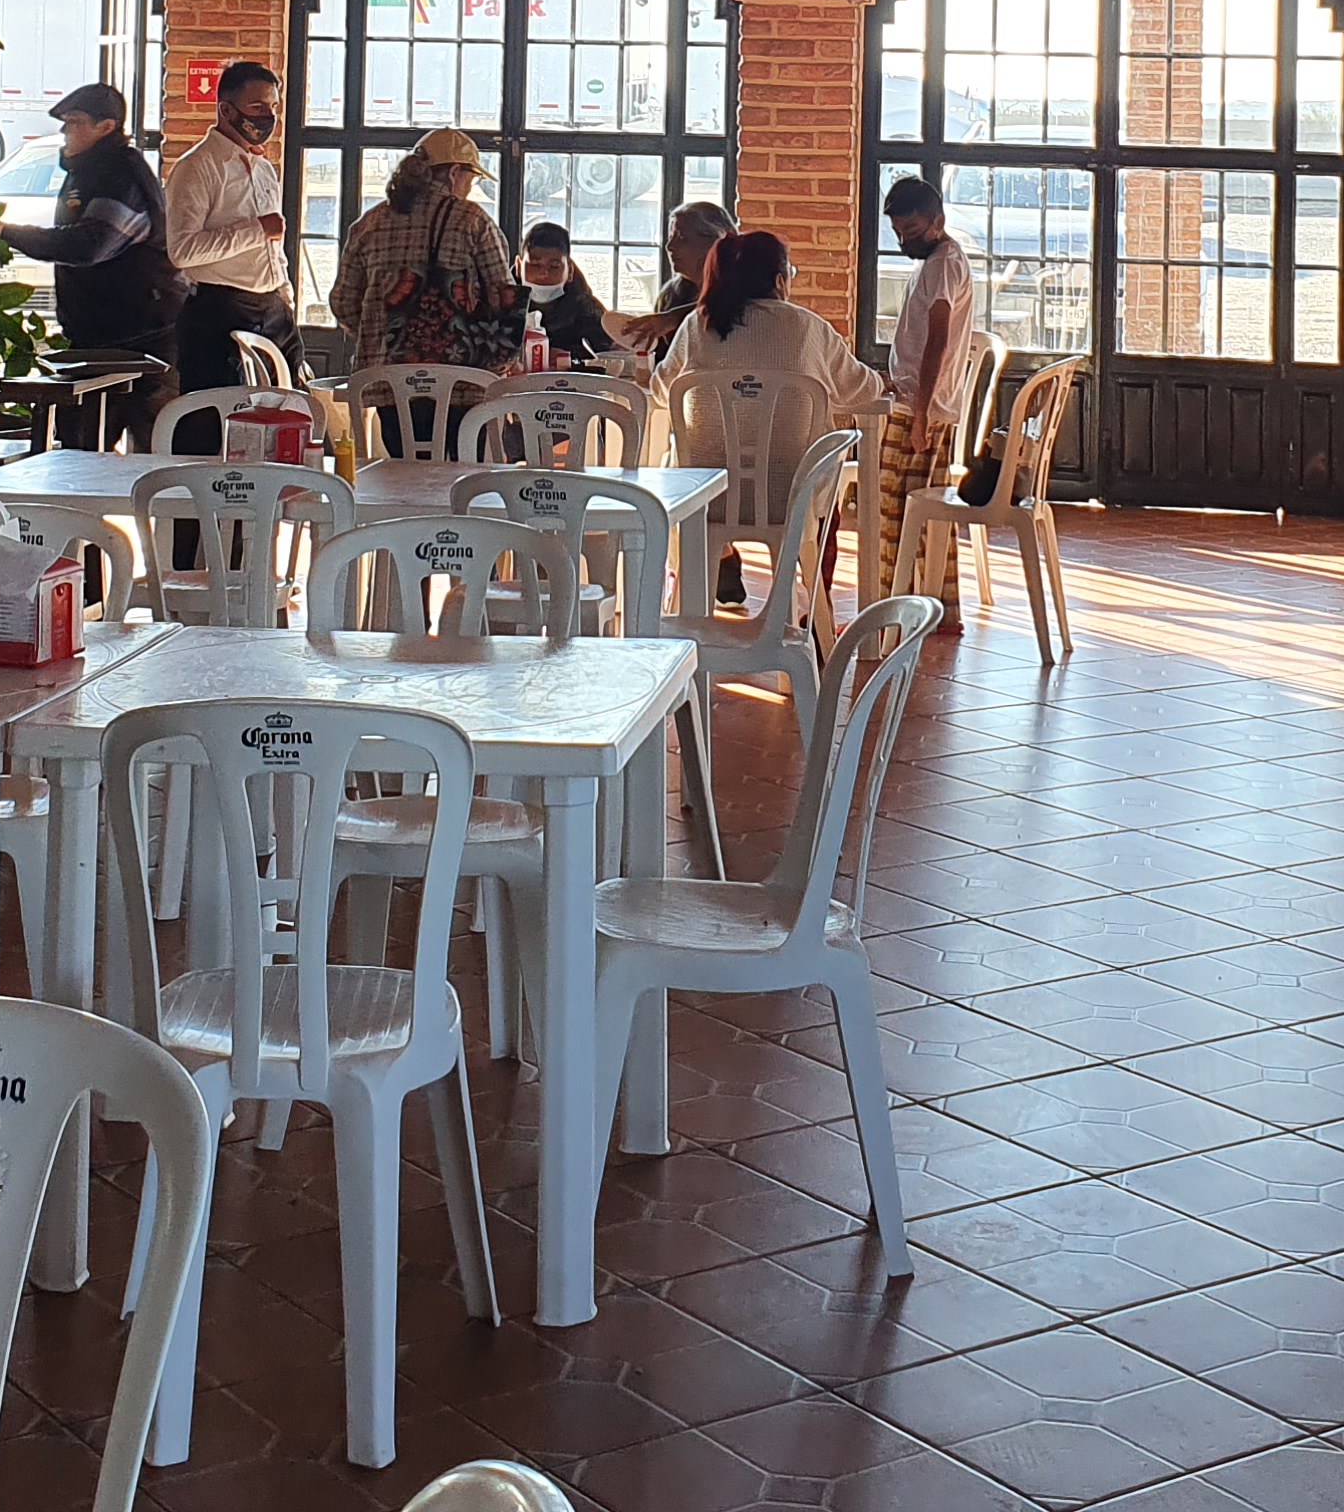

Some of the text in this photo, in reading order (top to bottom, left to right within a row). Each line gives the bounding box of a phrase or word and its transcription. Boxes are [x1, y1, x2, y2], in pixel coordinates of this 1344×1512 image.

[519, 487, 567, 503] Corona
[415, 542, 474, 563] Corona
[431, 559, 462, 571] Extra
[241, 727, 313, 750] Corona
[262, 745, 300, 759] Extra
